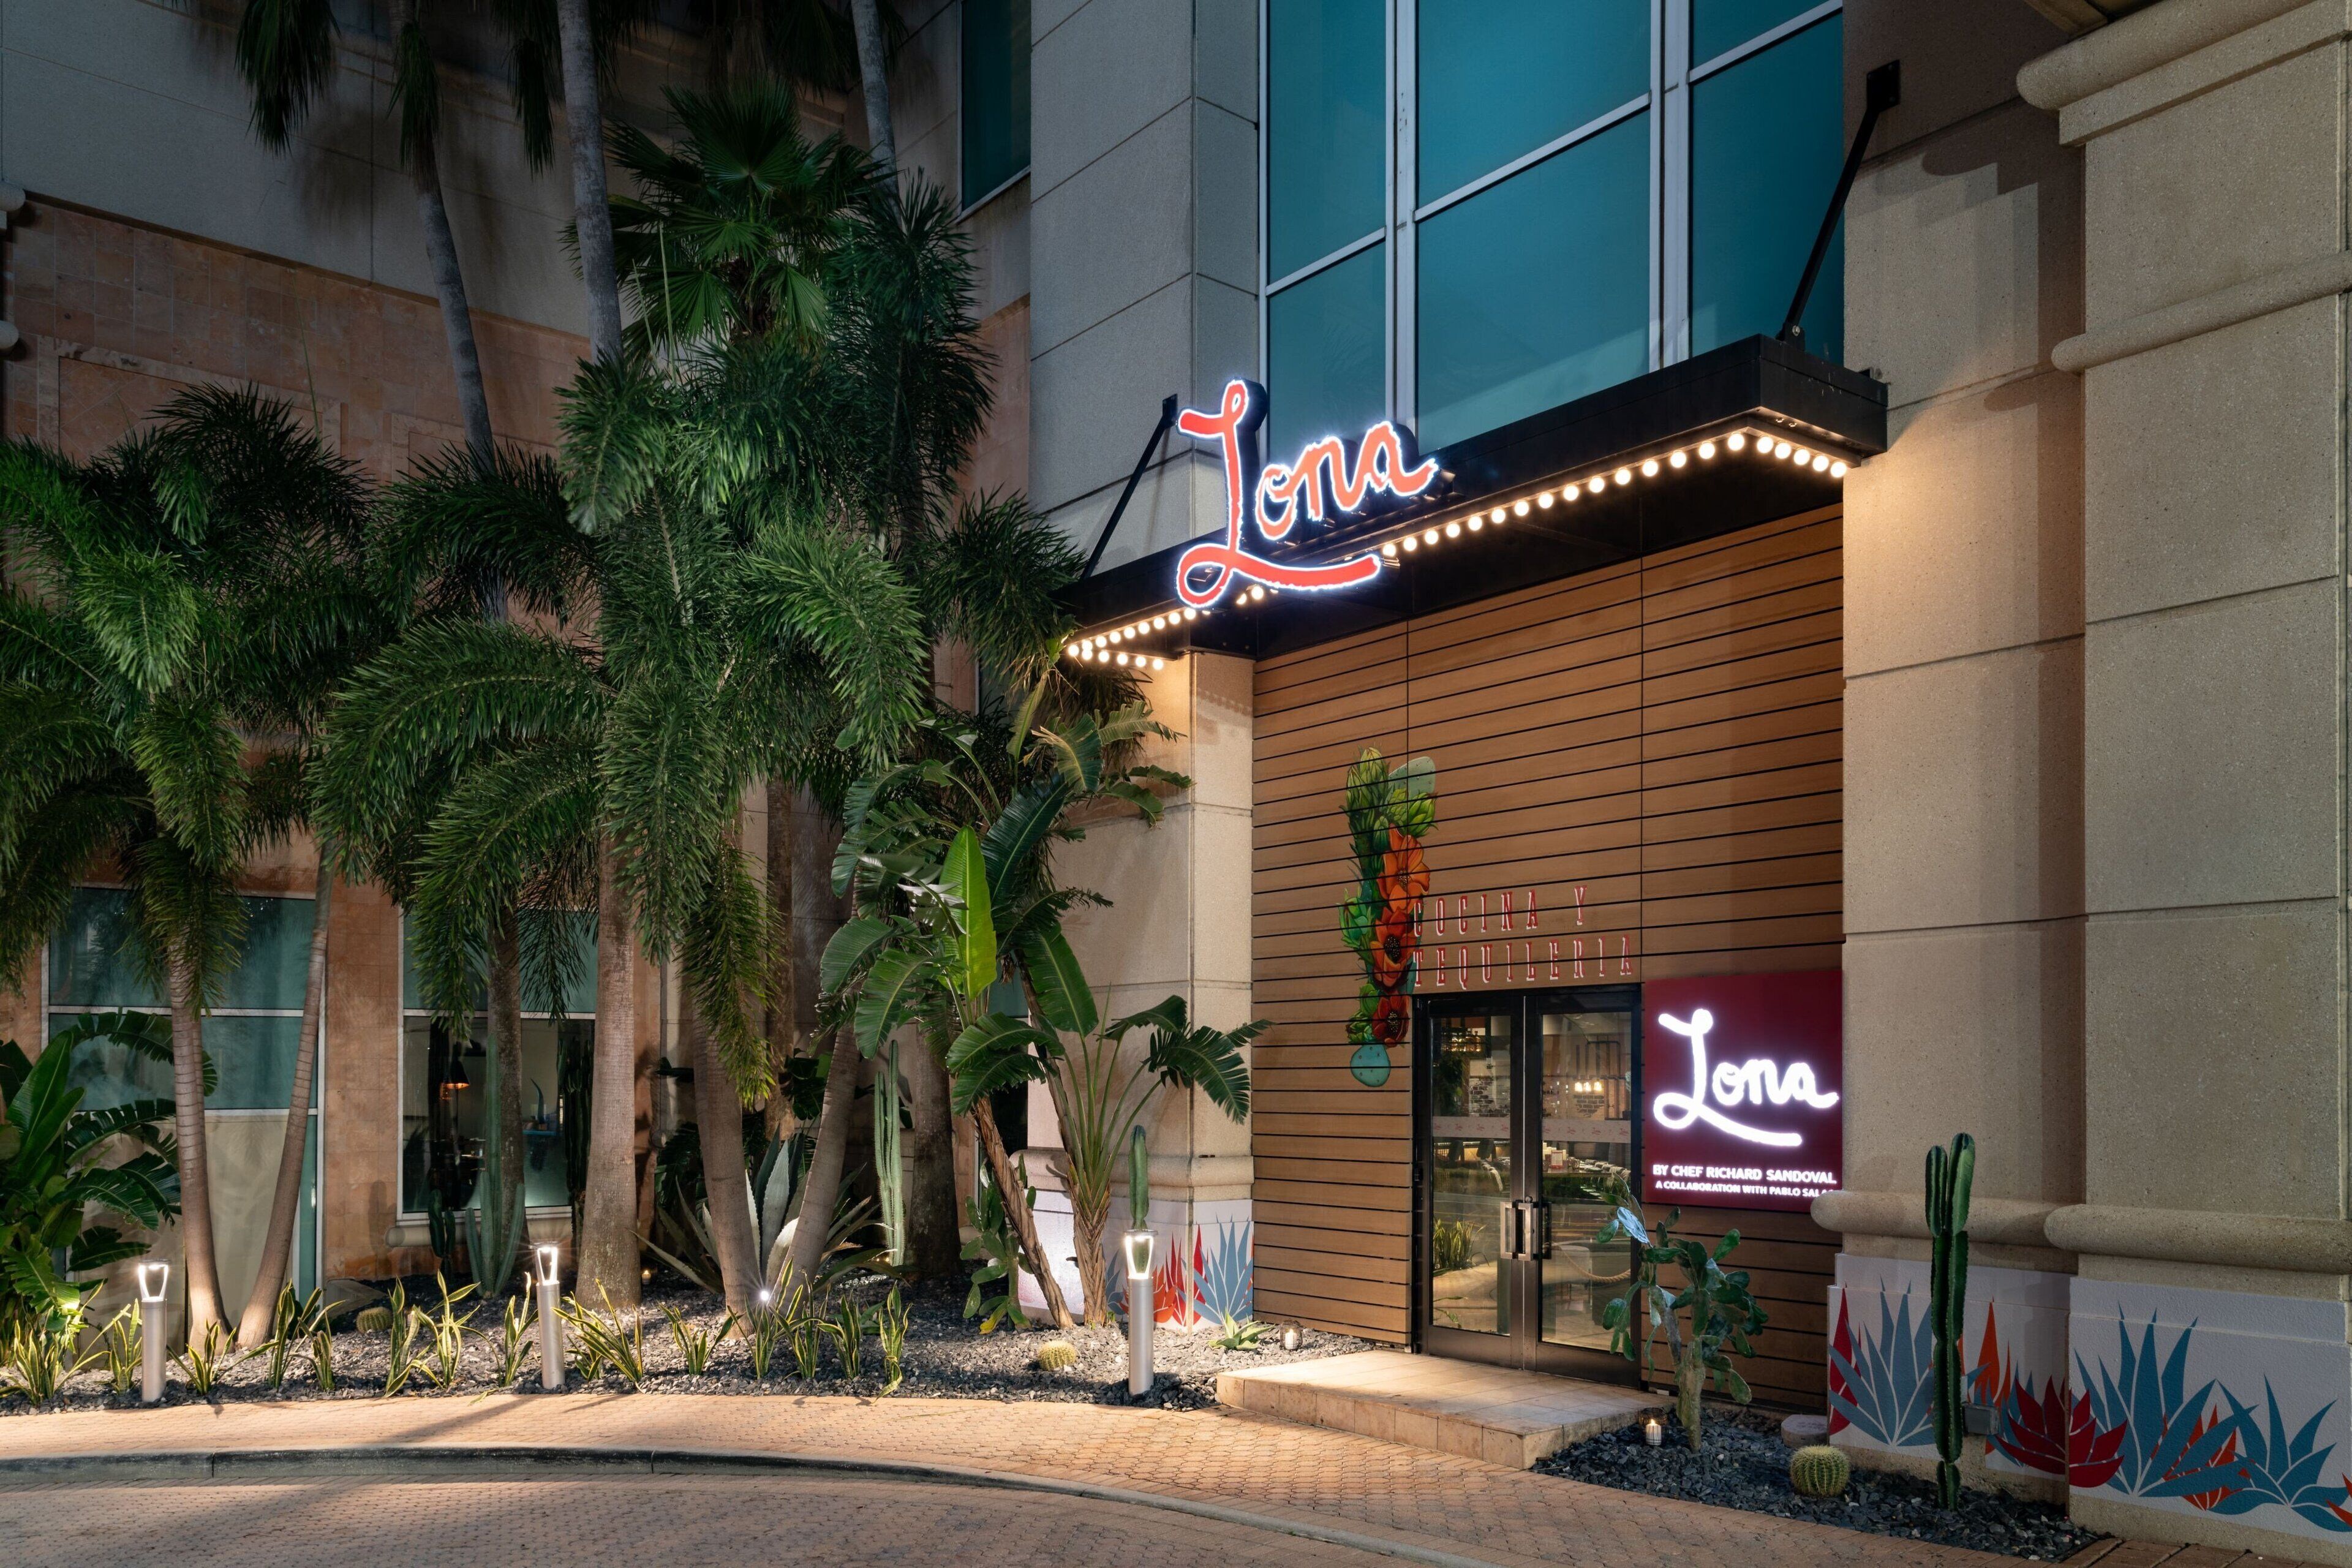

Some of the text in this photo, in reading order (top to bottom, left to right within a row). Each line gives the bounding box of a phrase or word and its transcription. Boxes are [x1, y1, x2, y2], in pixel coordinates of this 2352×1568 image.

[1176, 379, 1441, 608] Lona
[1413, 884, 1588, 937] COCINA Y
[1412, 934, 1632, 990] TEQUILERIA
[1653, 1008, 1839, 1147] Lona
[1653, 1164, 1837, 1184] BY CHEF RICHARD SANDOVAL
[1655, 1180, 1663, 1189] A
[1663, 1181, 1741, 1193] COLLABORATION
[1742, 1185, 1767, 1194] WITH
[1769, 1186, 1801, 1196] PABLO
